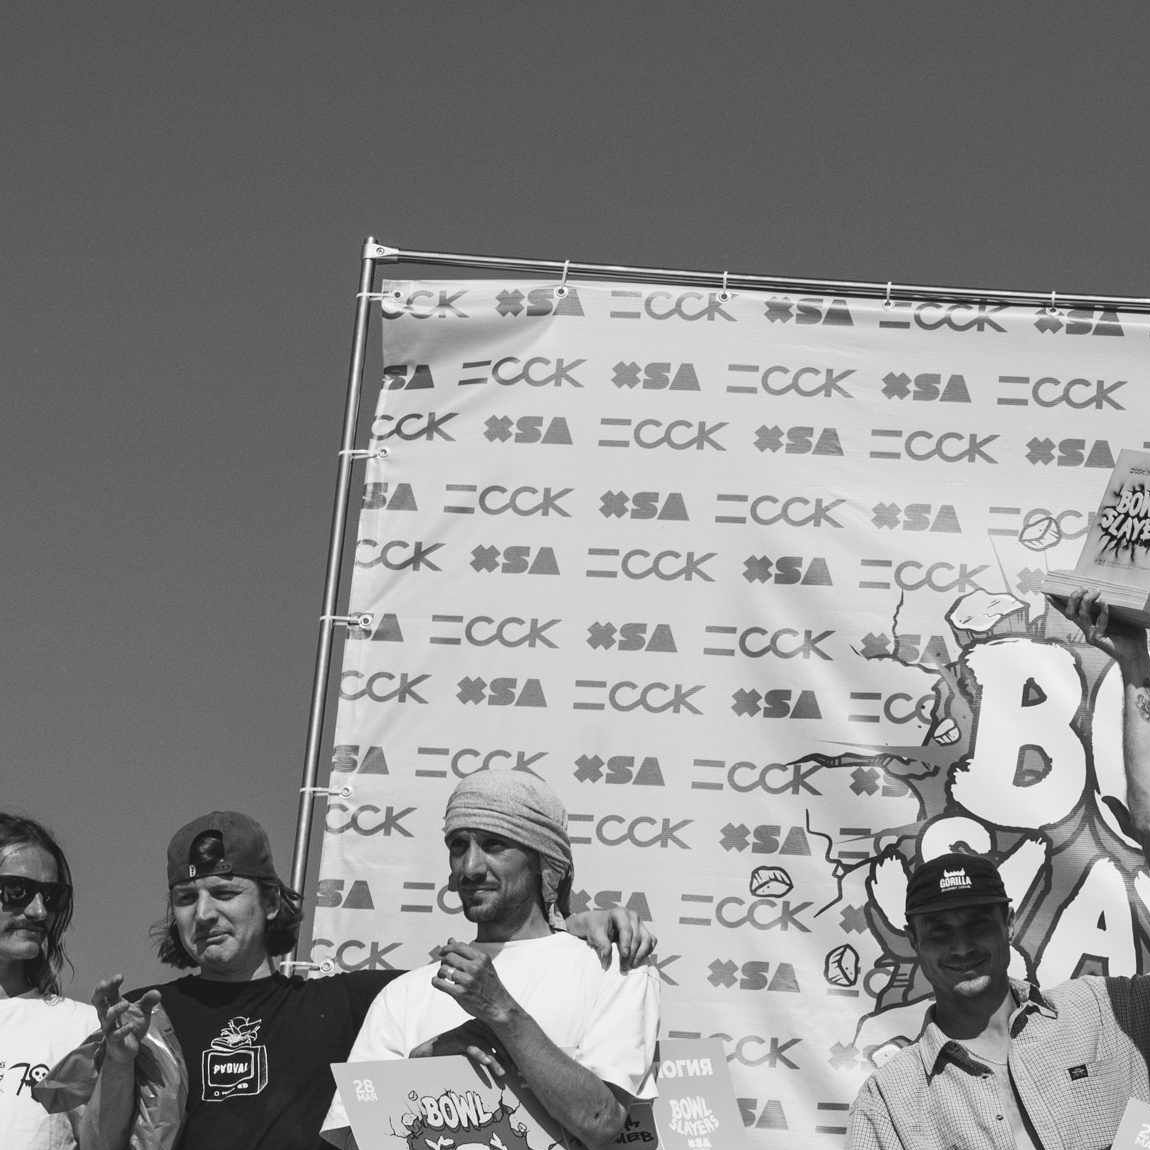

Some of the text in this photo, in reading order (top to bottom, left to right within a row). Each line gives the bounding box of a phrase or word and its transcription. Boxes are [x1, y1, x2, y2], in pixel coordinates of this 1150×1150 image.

[939, 876, 972, 889] GORILLA
[658, 1058, 714, 1078] ОГИЯ
[353, 1079, 375, 1094] 28
[357, 1093, 378, 1102] МАЯ
[422, 1091, 493, 1132] BOWL
[669, 1096, 712, 1120] BOWL
[669, 1115, 719, 1136] SLAYERS
